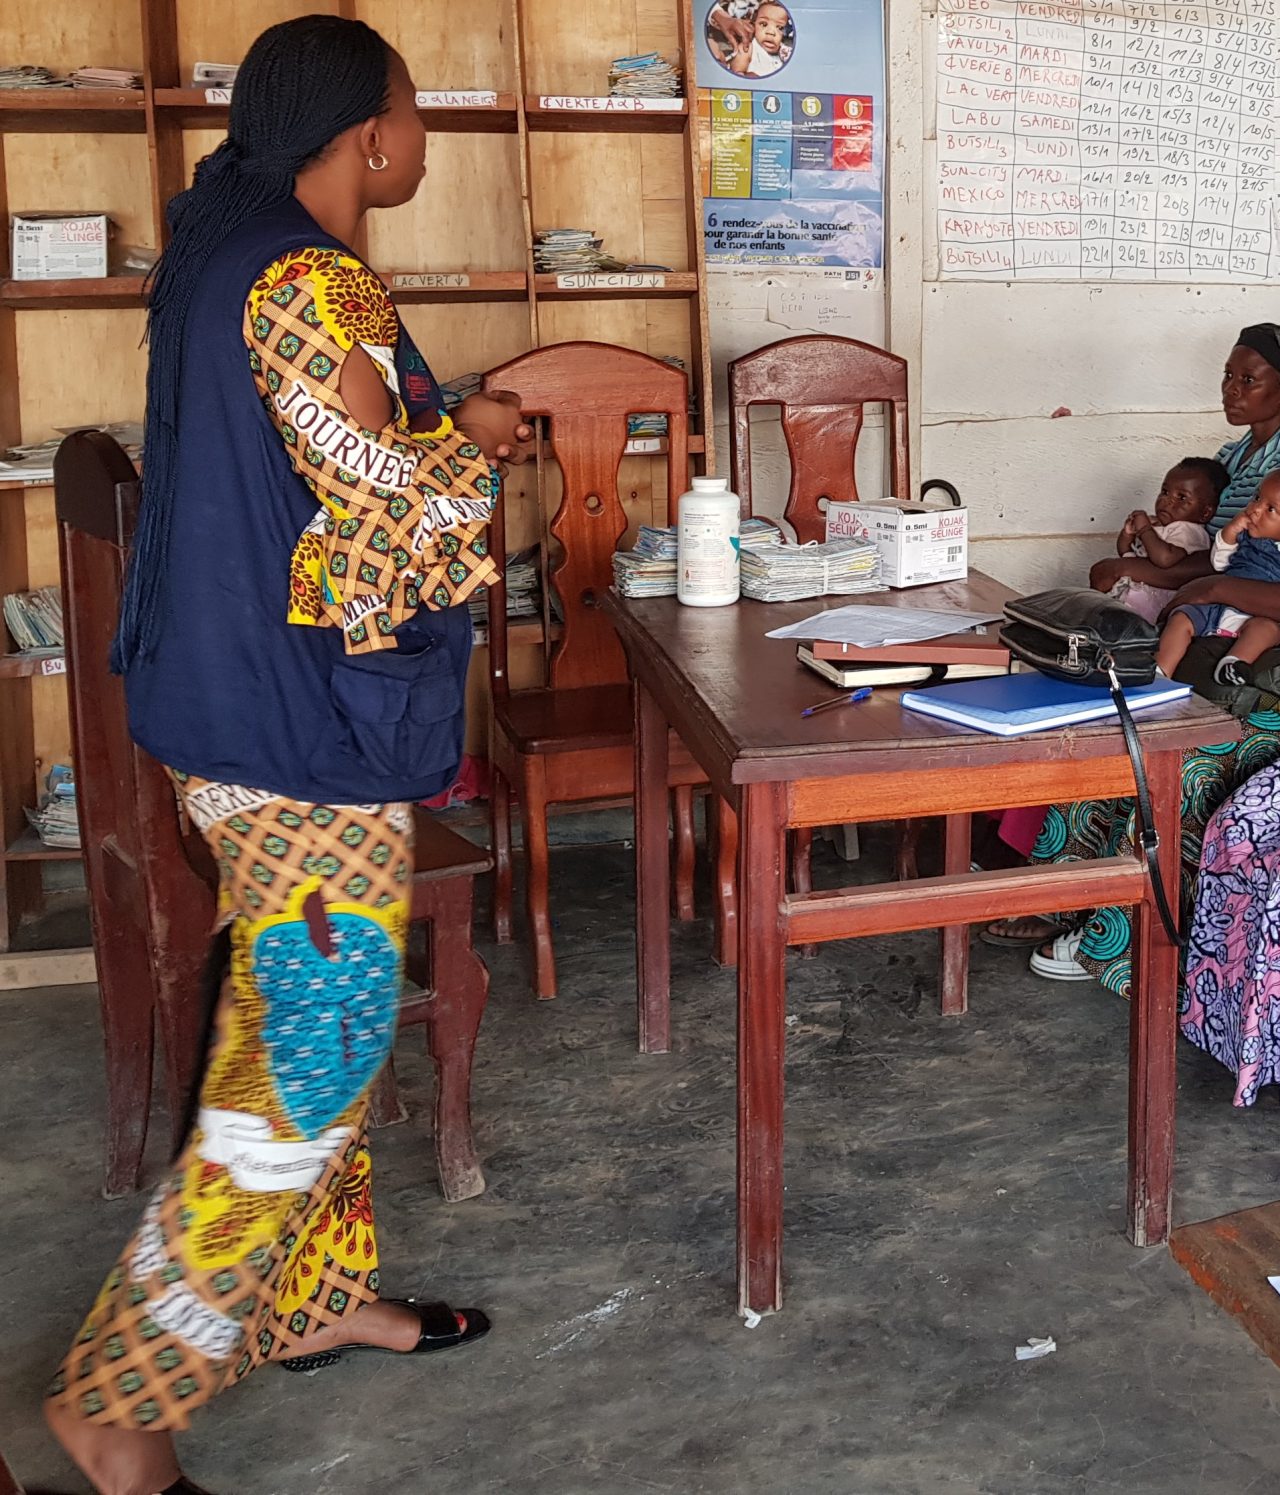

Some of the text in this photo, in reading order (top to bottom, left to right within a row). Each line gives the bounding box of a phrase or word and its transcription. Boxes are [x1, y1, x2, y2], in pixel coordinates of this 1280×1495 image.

[1092, 34, 1112, 49] 8/1
[1020, 47, 1066, 64] MARDI
[946, 80, 979, 96] LAC
[726, 94, 738, 110] 3
[766, 95, 777, 113] 4
[806, 97, 817, 115] 5
[848, 99, 859, 116] 6
[952, 108, 1001, 126] LABU
[1020, 115, 1074, 131] SAMEDI
[1025, 138, 1073, 156] LUNDI
[1017, 167, 1068, 183] MARDI
[943, 187, 1005, 202] MEXICO
[708, 213, 717, 227] 6
[800, 218, 809, 229] la
[766, 230, 775, 239] la
[714, 240, 726, 249] de
[750, 241, 785, 251] enfants
[419, 275, 450, 287] VERT
[562, 275, 644, 287] SUN-CITY
[939, 516, 964, 528] KOJAK
[931, 527, 964, 539] SELINGE
